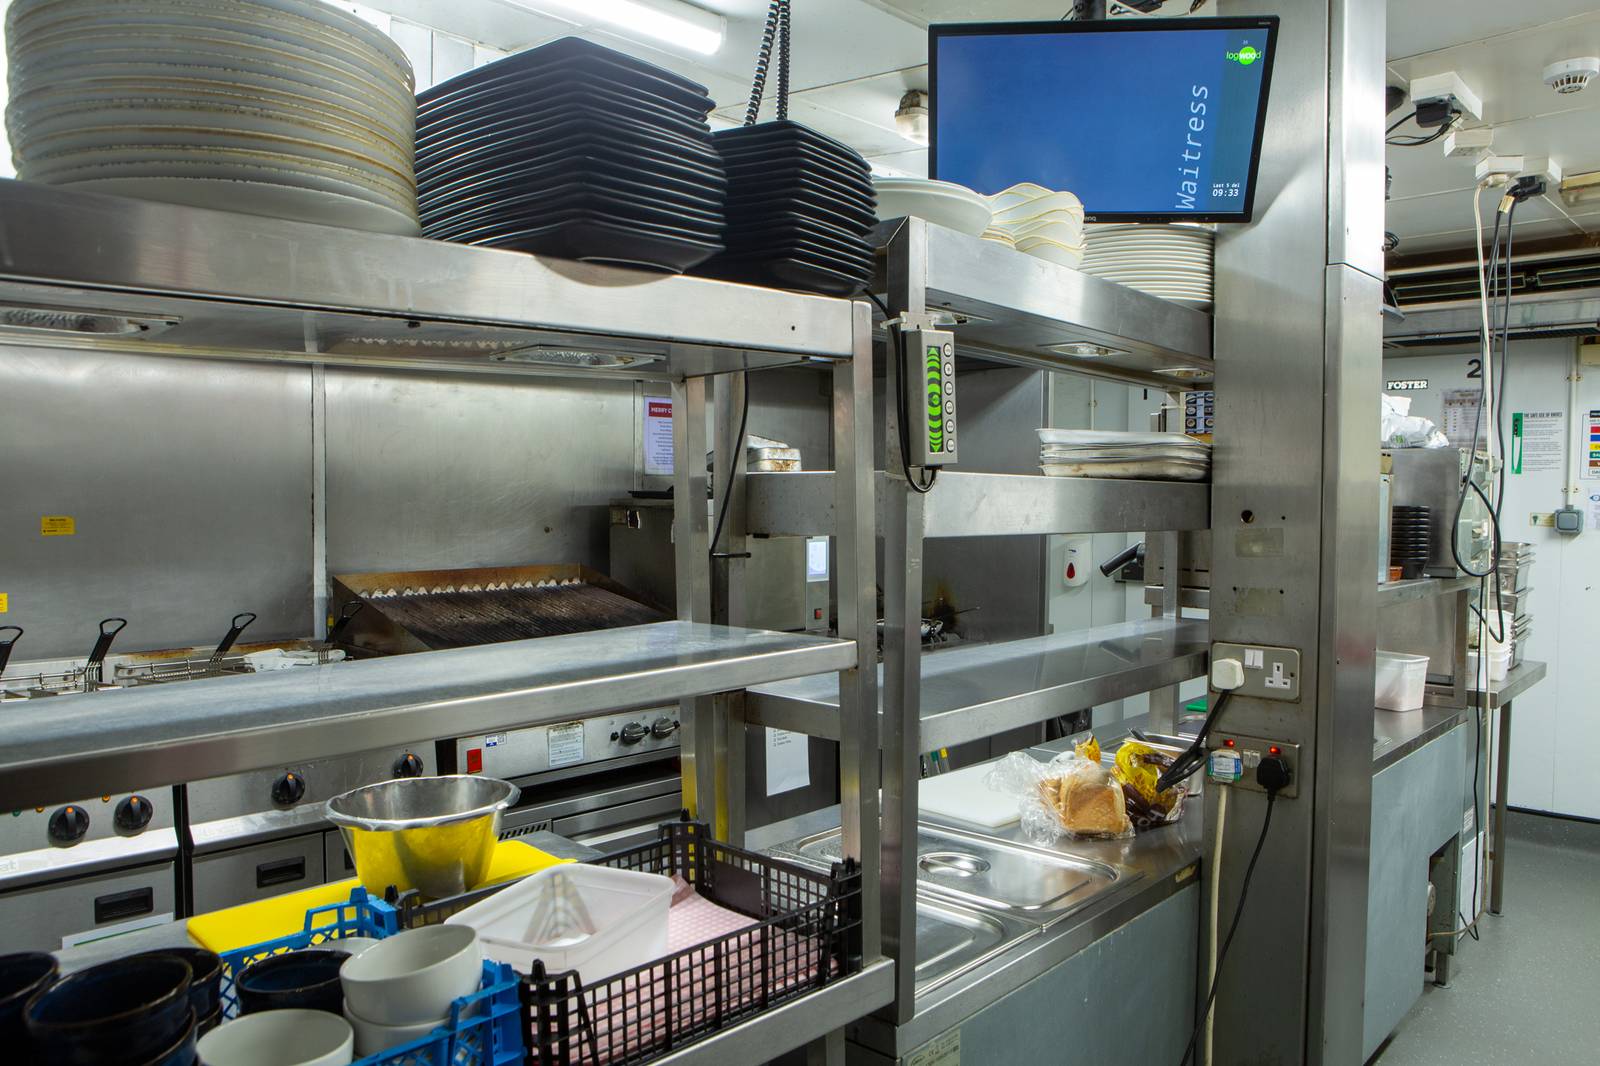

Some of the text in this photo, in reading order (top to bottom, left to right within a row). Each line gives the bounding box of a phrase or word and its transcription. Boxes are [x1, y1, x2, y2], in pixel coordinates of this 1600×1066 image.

[1226, 50, 1262, 61] logwood
[1175, 84, 1208, 210] Waitress
[1212, 189, 1239, 197] 09:33
[1467, 359, 1481, 378] 2
[1387, 380, 1428, 390] FOSTER
